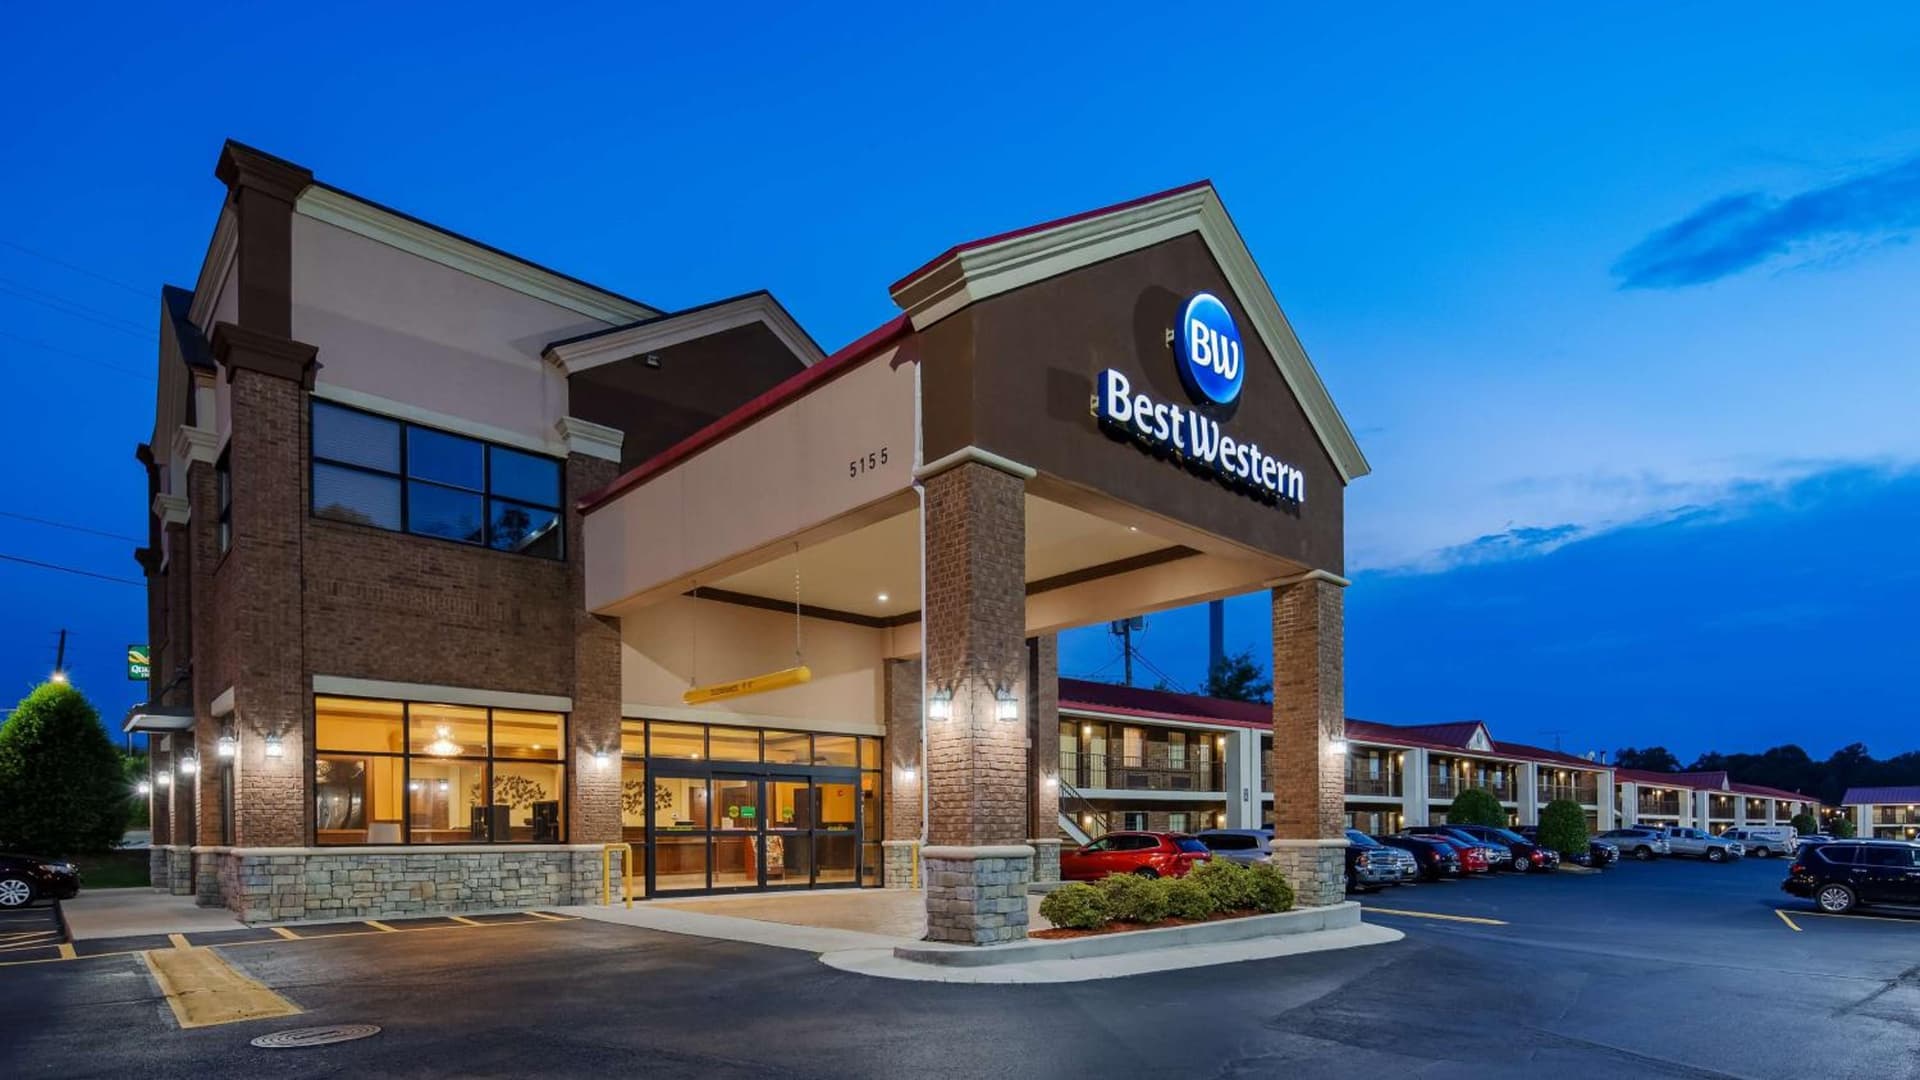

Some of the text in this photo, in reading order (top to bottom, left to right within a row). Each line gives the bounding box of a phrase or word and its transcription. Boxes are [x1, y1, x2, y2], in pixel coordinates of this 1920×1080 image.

[1190, 318, 1239, 381] BW
[850, 447, 888, 478] 5155
[1107, 367, 1304, 503] Best Western
